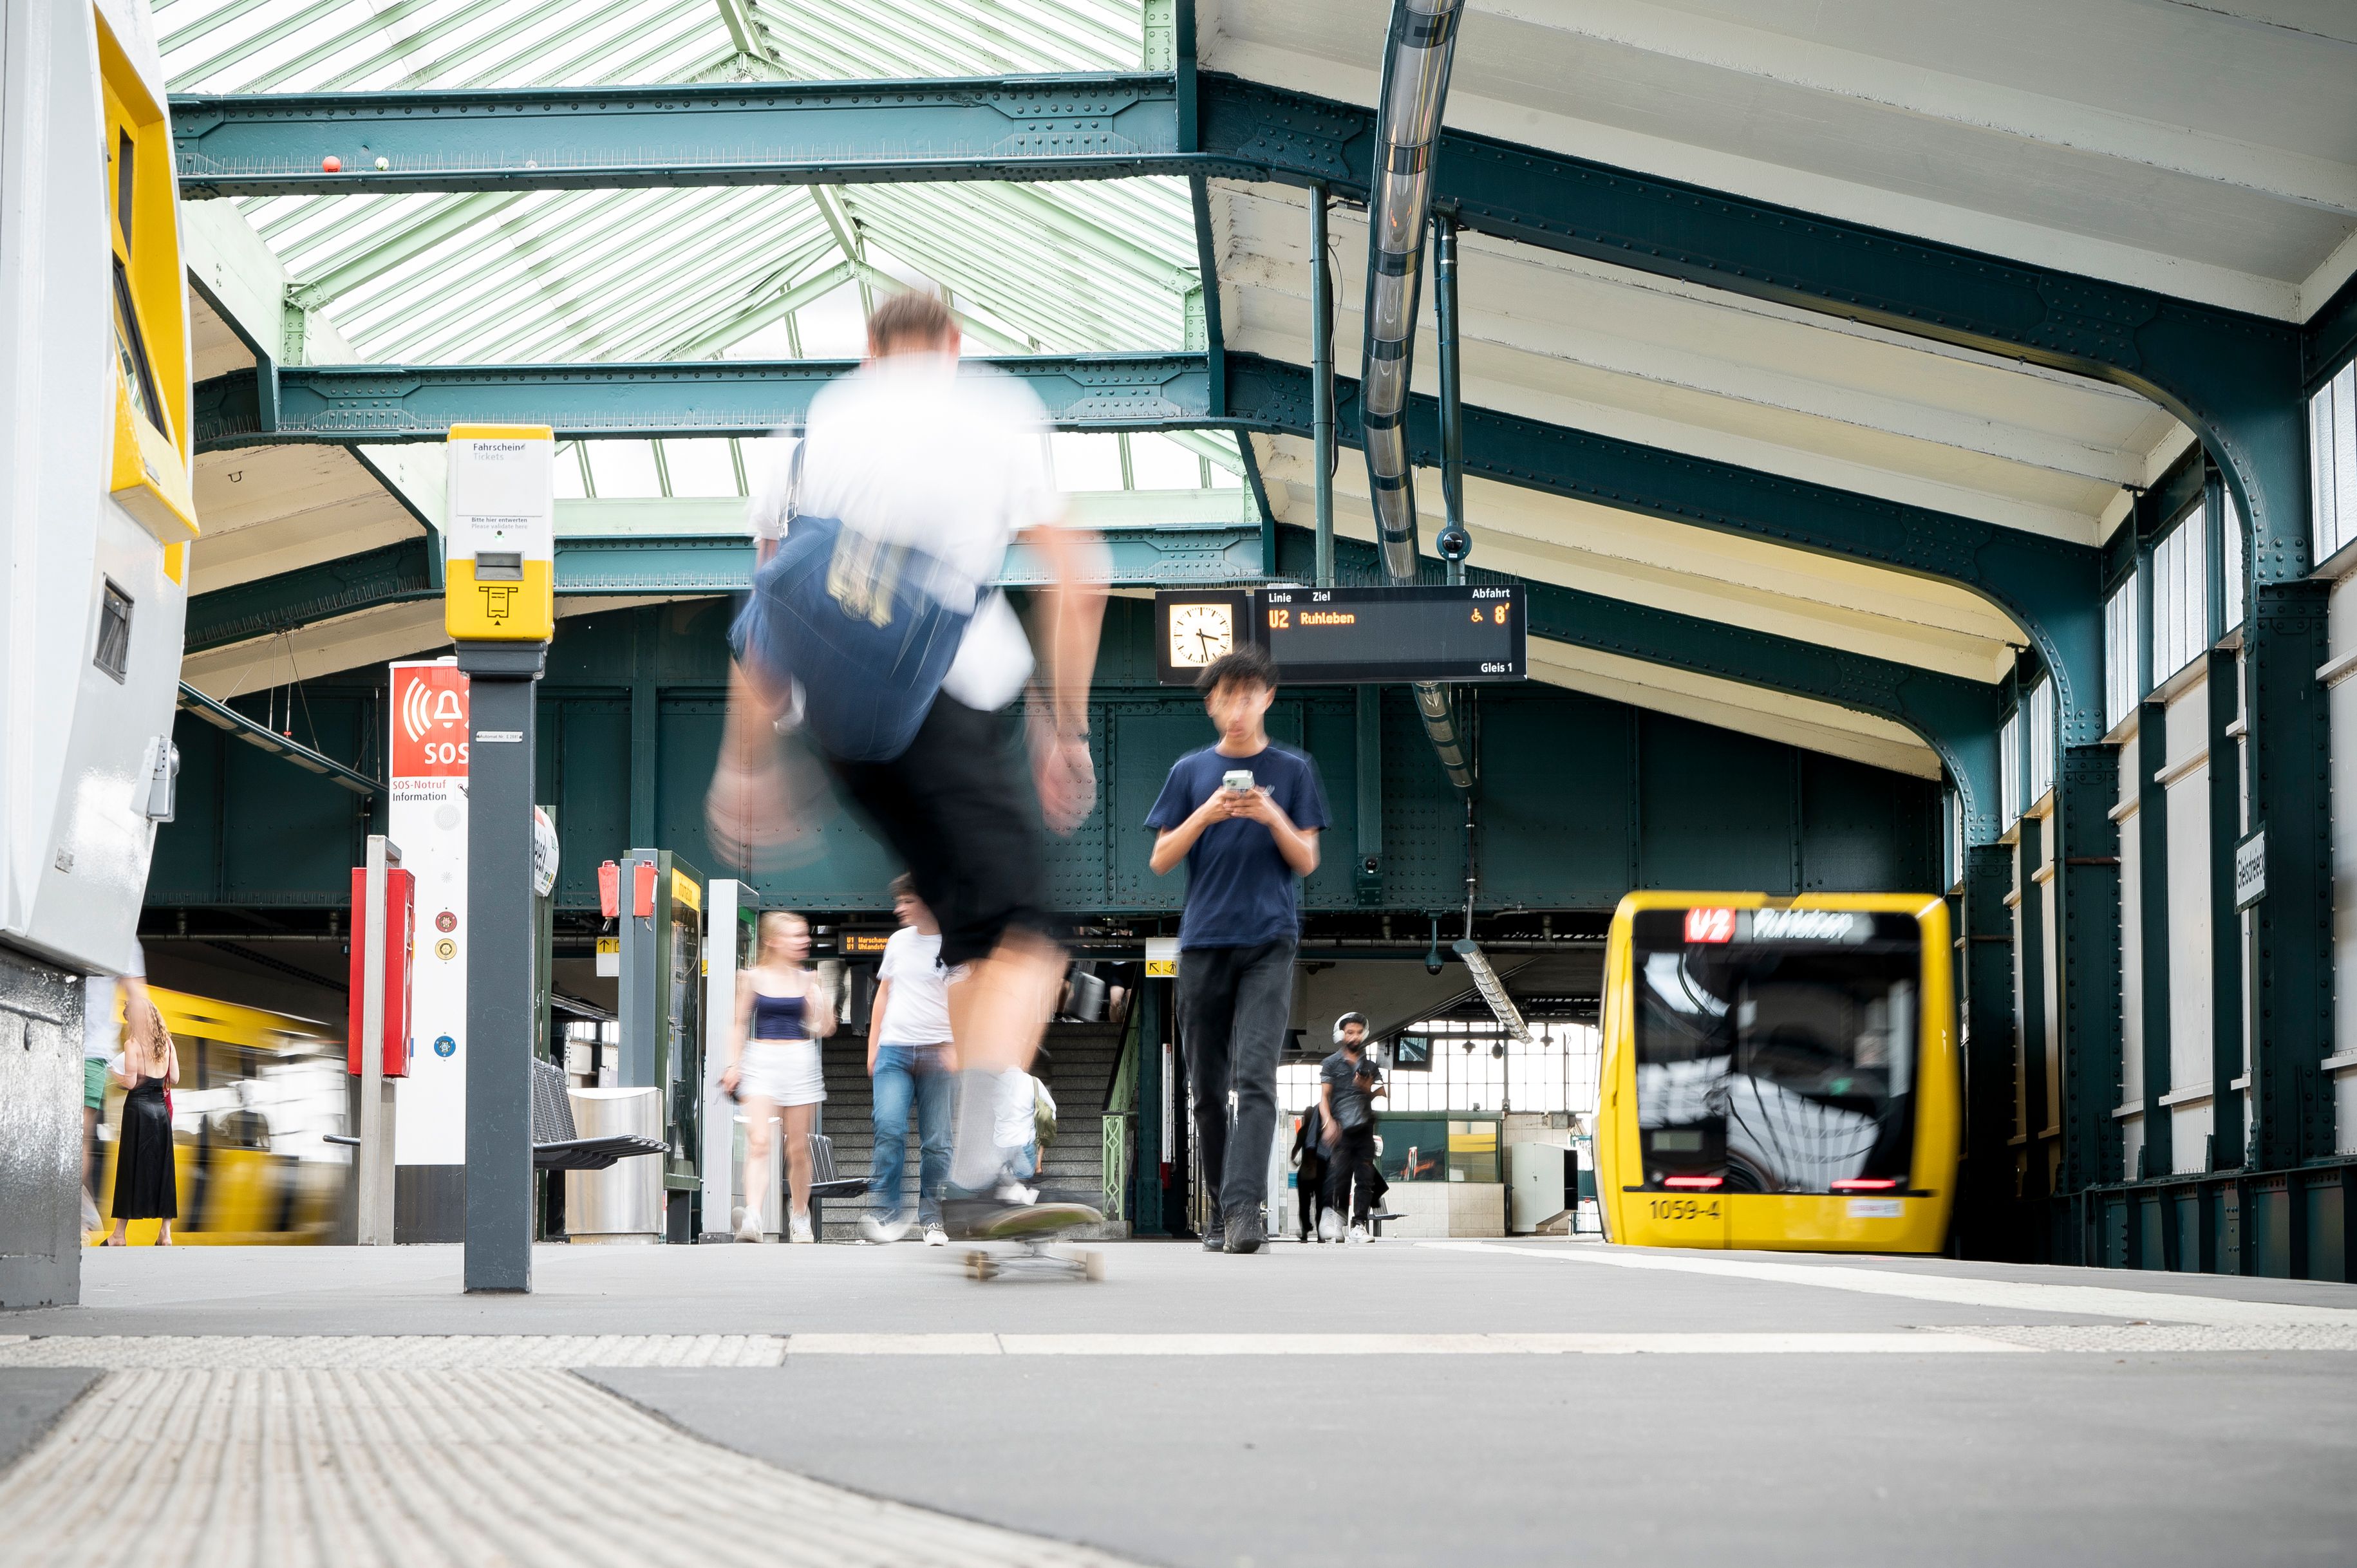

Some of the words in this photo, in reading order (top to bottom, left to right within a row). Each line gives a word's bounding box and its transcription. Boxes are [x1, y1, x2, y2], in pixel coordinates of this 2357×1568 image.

[473, 453, 504, 461] Tickets
[1268, 593, 1291, 602] Linie
[1312, 591, 1331, 601] Ziel
[1472, 588, 1510, 599] Abfahrt
[1268, 610, 1289, 628] U2
[1301, 611, 1355, 624] Ruhleben
[1481, 662, 1505, 673] Gleis
[1507, 662, 1512, 672] 1
[424, 742, 469, 765] SOS
[393, 779, 447, 789] SOS-Notruf
[393, 792, 447, 801] Information
[2237, 842, 2265, 890] Gleisdreieck
[1649, 1199, 1722, 1220] 1059-4
